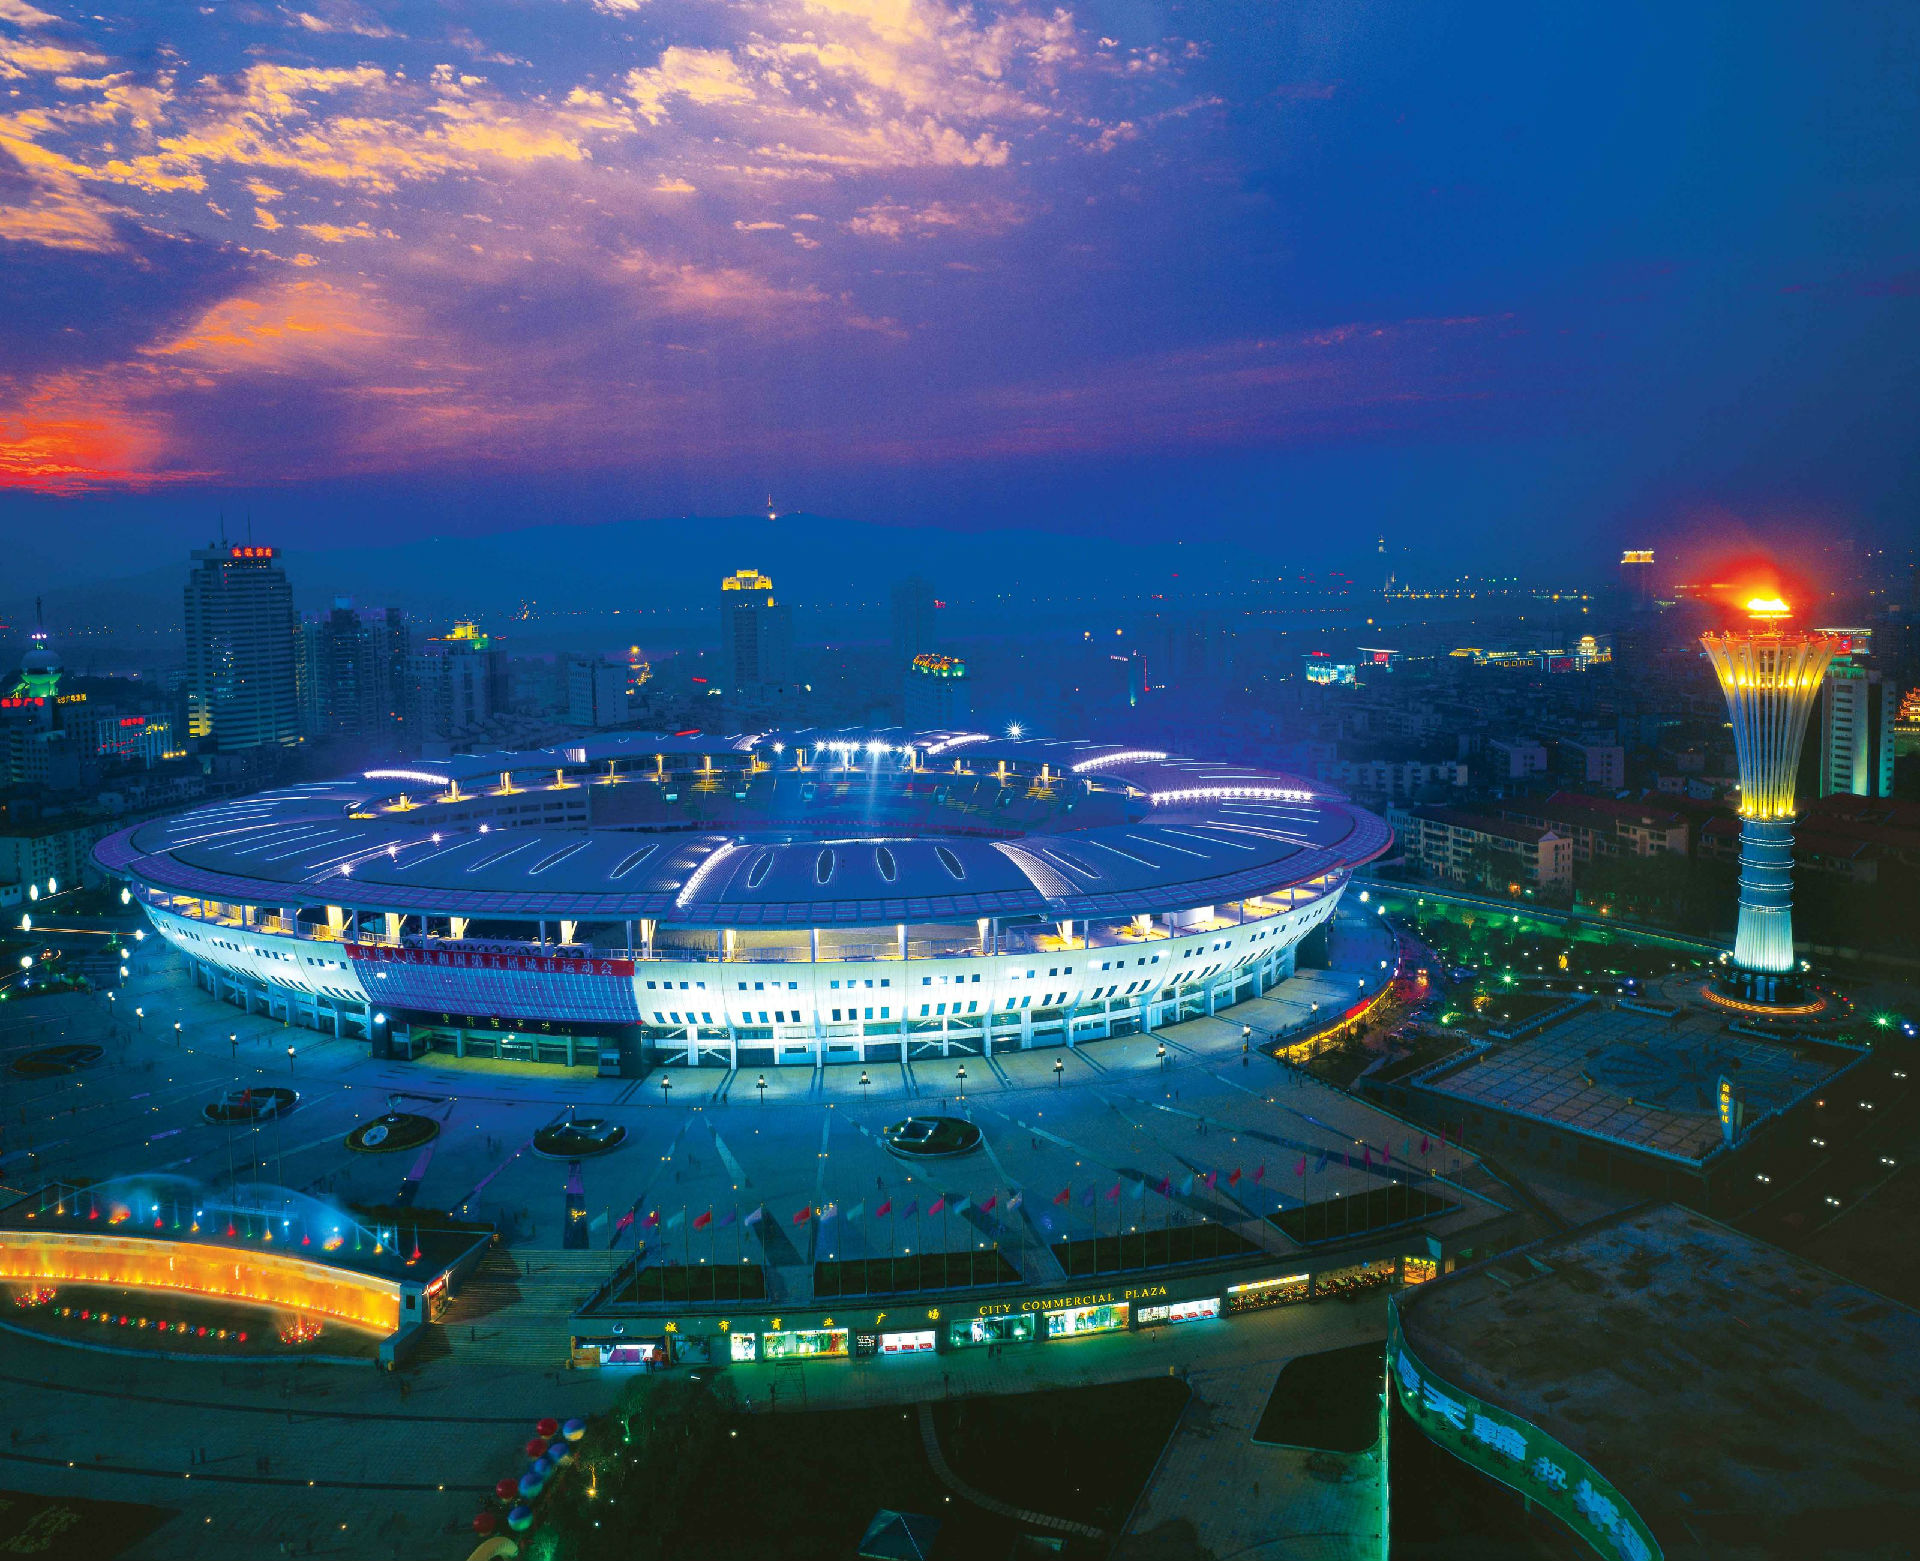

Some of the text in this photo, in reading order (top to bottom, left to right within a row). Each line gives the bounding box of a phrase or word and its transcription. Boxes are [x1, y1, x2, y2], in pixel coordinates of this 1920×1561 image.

[357, 948, 613, 976] 中华人民共和国第五届城市运动会
[979, 1286, 1167, 1316] CITY COMMERCIAL PLAZA
